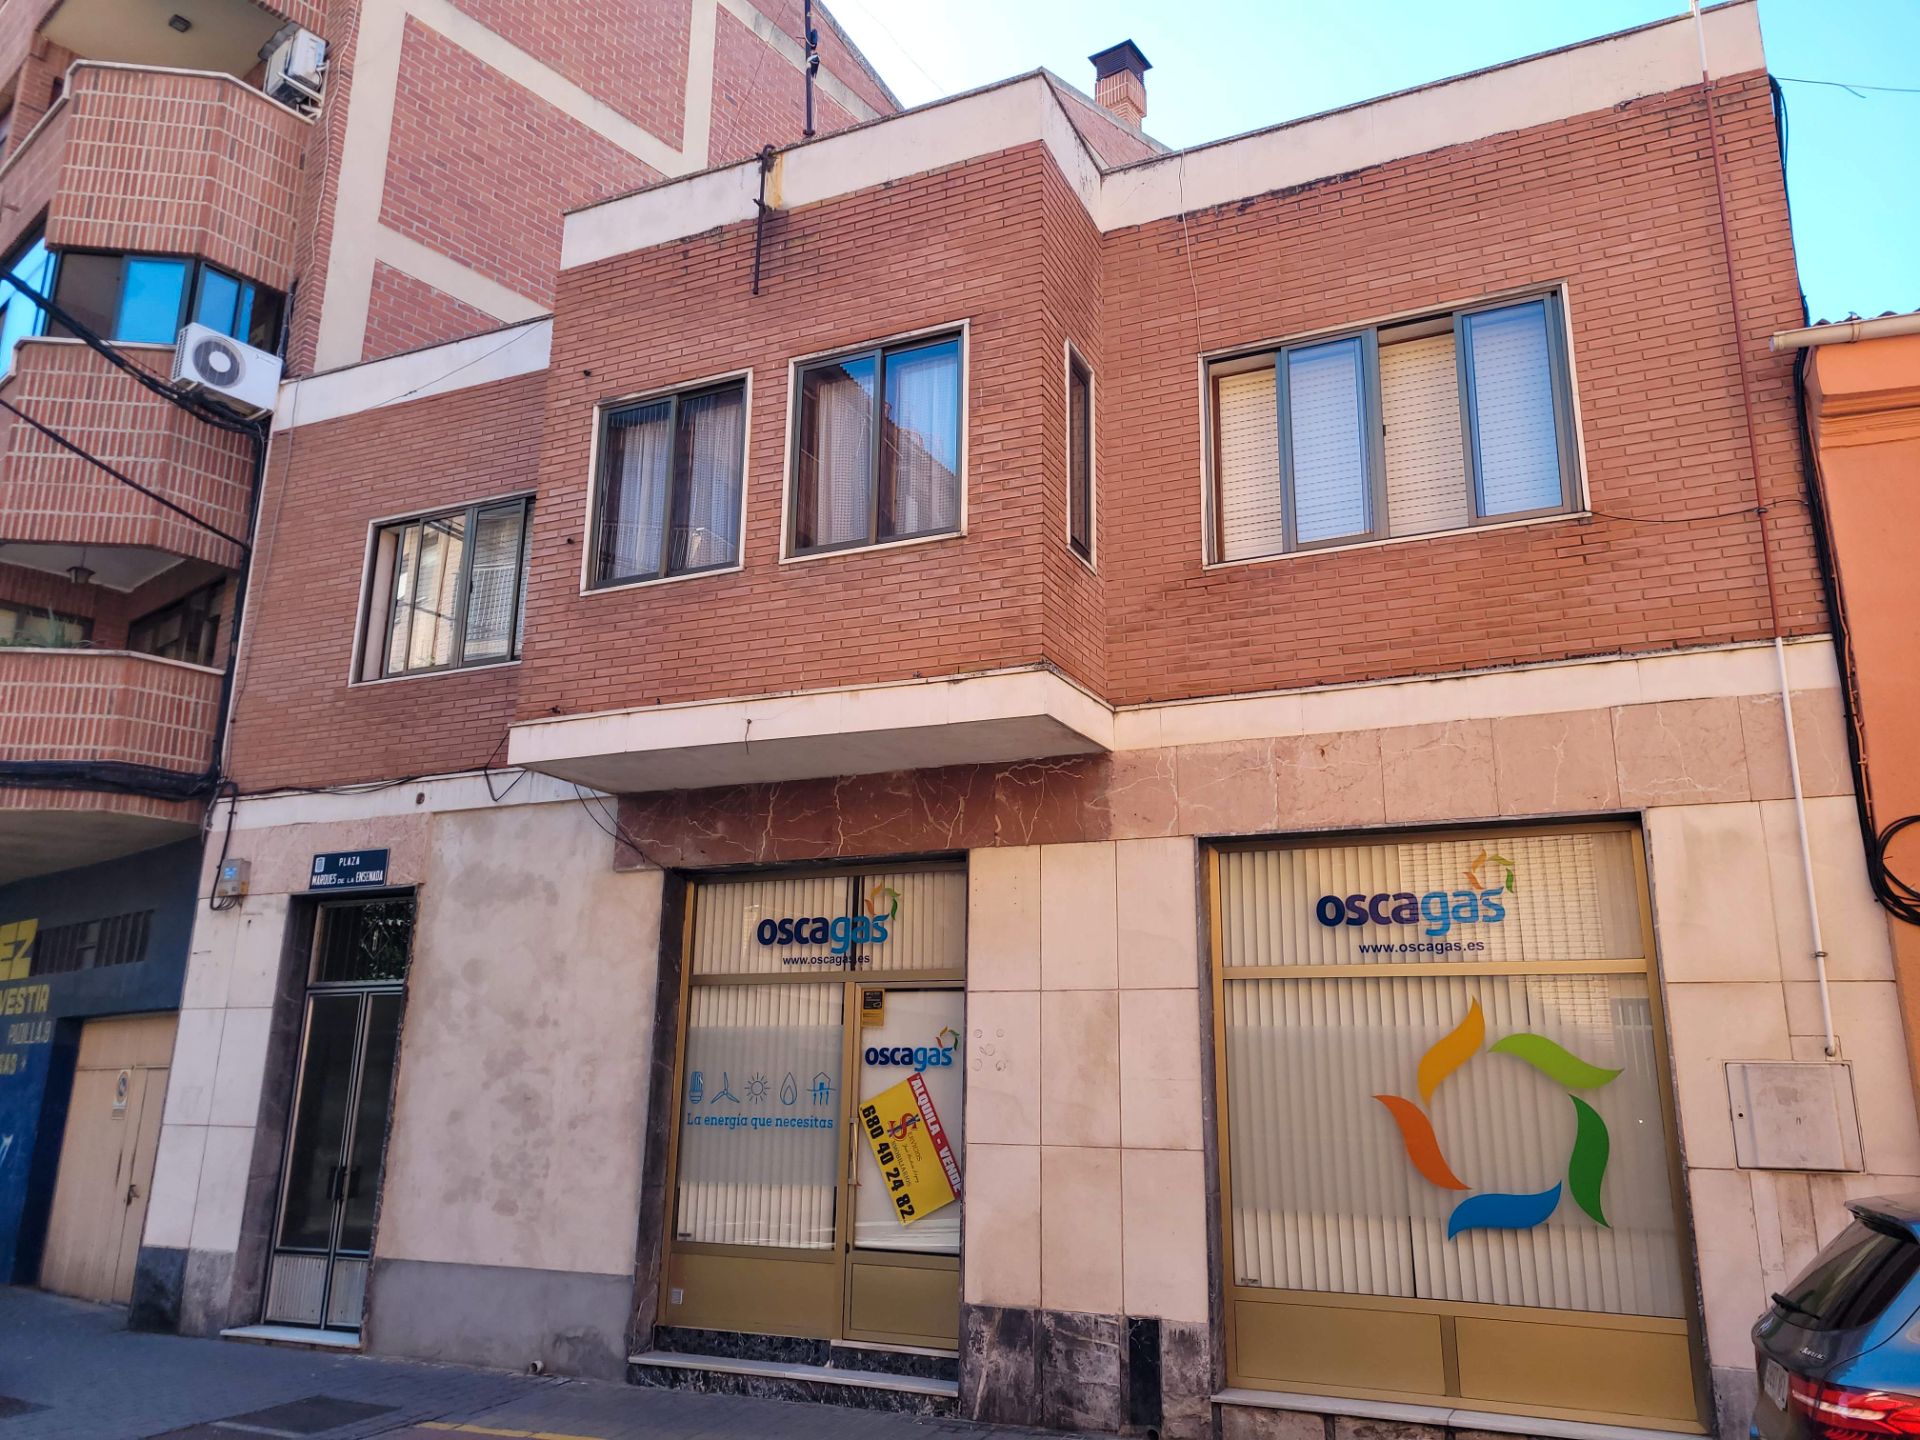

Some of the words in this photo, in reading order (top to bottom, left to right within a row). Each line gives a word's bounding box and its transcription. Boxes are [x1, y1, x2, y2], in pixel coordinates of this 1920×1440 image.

[338, 856, 360, 867] PLAZA
[311, 873, 337, 886] MARQUES
[1316, 887, 1505, 936] oscagas
[757, 914, 889, 954] oscagas
[1359, 940, 1484, 954] www.oscagas.es
[783, 954, 870, 966] www.oscagas.es
[865, 1046, 953, 1072] oscagas
[912, 1077, 940, 1136] ALQUILA
[687, 1113, 701, 1126] La
[750, 1117, 772, 1130] que
[775, 1115, 834, 1129] necesitas
[862, 1104, 884, 1139] 680
[876, 1142, 894, 1166] 40
[886, 1167, 905, 1192] 24
[895, 1193, 915, 1219] 82
